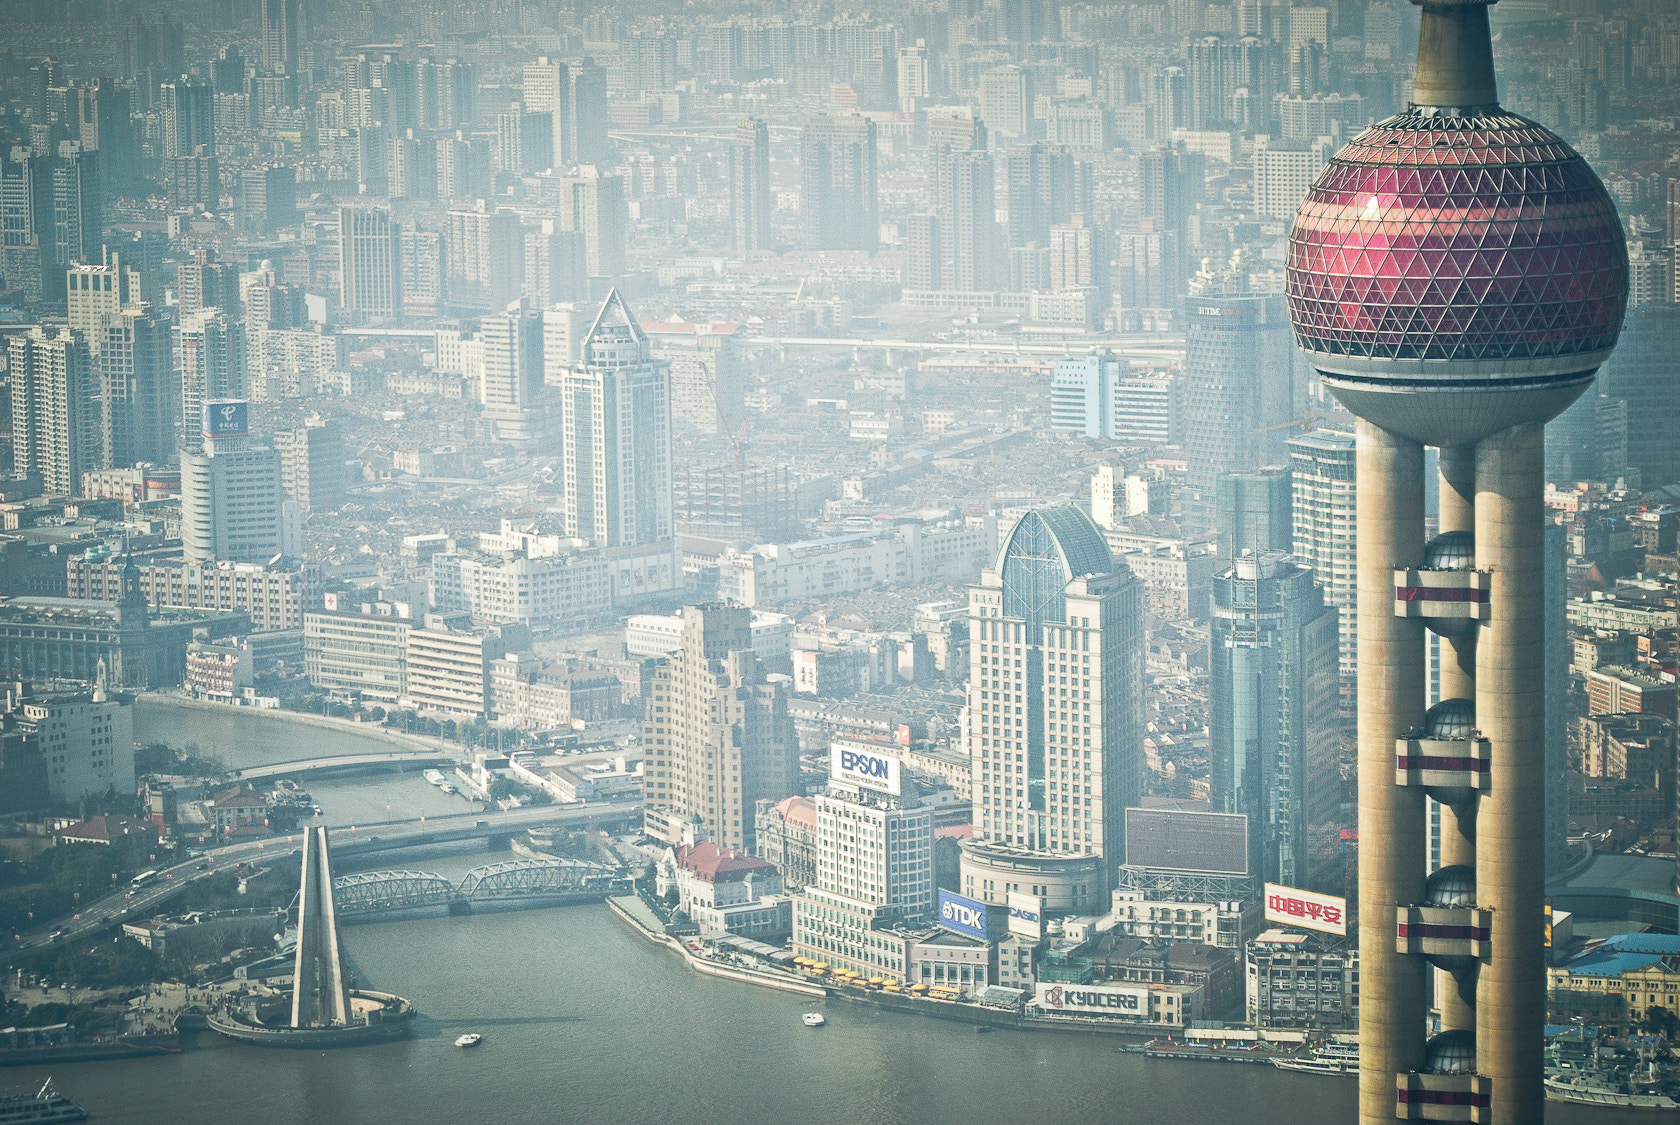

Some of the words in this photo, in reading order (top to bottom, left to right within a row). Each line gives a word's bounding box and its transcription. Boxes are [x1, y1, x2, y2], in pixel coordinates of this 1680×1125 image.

[841, 750, 888, 780] EPSON
[951, 902, 983, 930] TDK
[1008, 906, 1040, 924] CASIO
[1269, 894, 1342, 925] 中国平安
[1064, 990, 1138, 1010] KYOCERA
